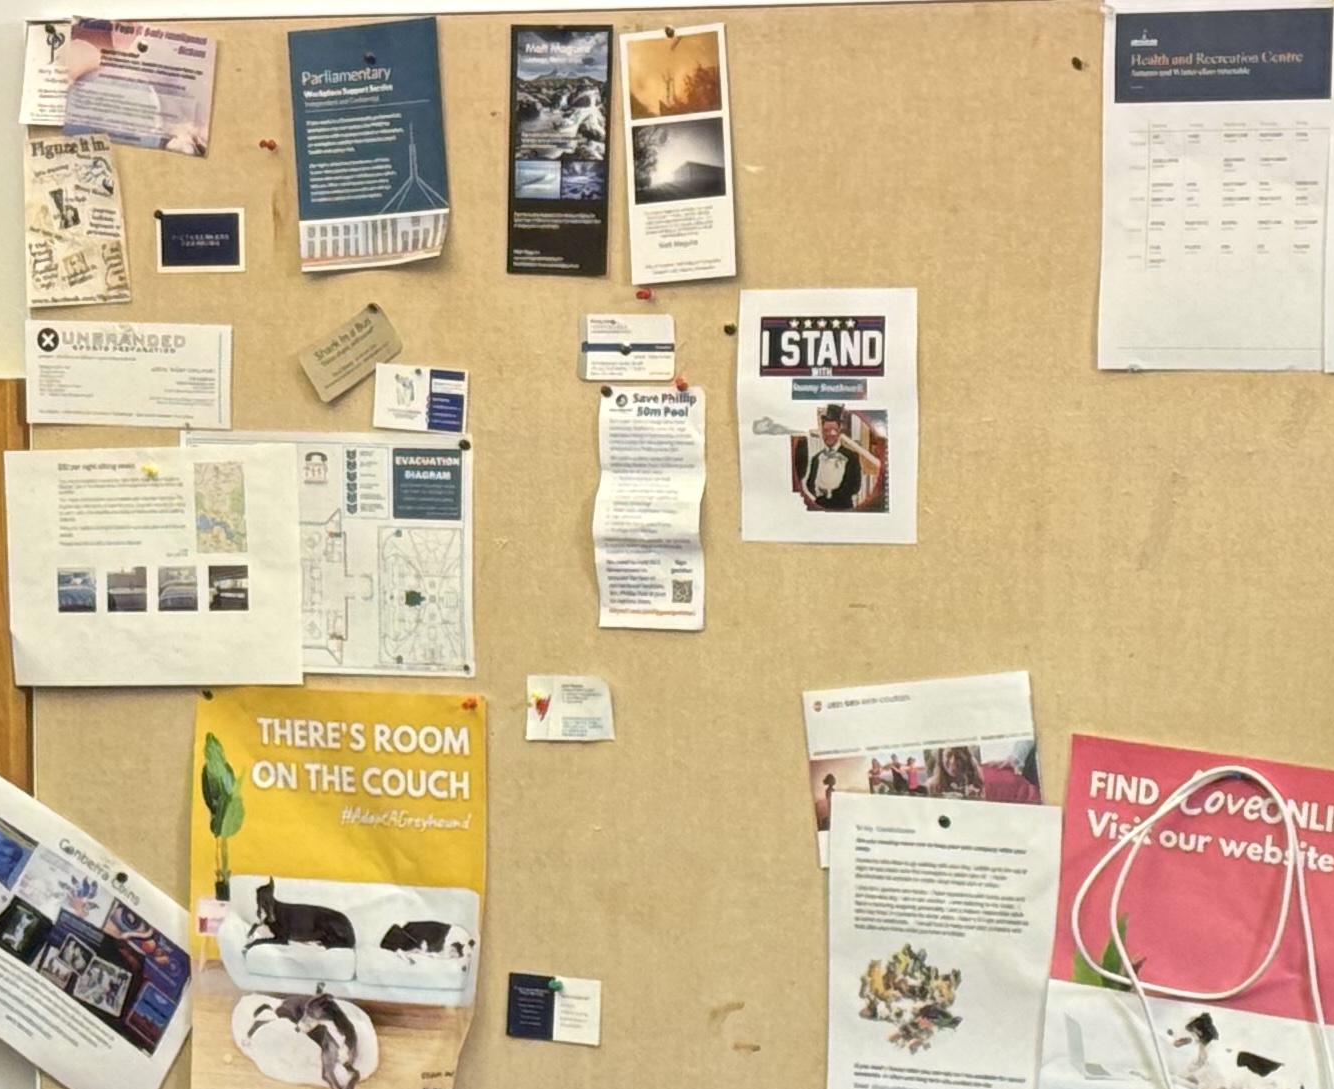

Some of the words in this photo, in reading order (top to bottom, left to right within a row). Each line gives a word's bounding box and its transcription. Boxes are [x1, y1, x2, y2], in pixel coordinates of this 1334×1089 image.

[1131, 53, 1169, 67] Health
[1171, 53, 1193, 65] and
[1196, 51, 1259, 65] Recreation
[1262, 51, 1303, 63] Centre
[301, 67, 391, 86] Parliamentary
[31, 139, 77, 160] Figure
[79, 137, 91, 153] it
[62, 331, 186, 350] UNBRANDED
[313, 339, 340, 361] Shark
[761, 330, 770, 366] I
[781, 330, 883, 367] STAND
[632, 393, 659, 404] Save
[661, 392, 697, 408] Phillip
[636, 406, 662, 418] 50m
[664, 406, 689, 418] Pool
[395, 456, 460, 466] EVACUATION
[404, 470, 452, 481] DIAGRAM
[257, 717, 366, 752] THERE'S
[373, 723, 470, 756] ROOM
[252, 760, 298, 790] ON
[305, 762, 357, 793] THE
[363, 766, 470, 800] COUCH
[1090, 770, 1159, 805] FIND
[341, 804, 471, 832] #AdoptAGreyhound
[1088, 809, 1153, 847] Visit
[1159, 829, 1213, 854] our
[58, 838, 112, 883] Canberra
[110, 876, 141, 907] Coins
